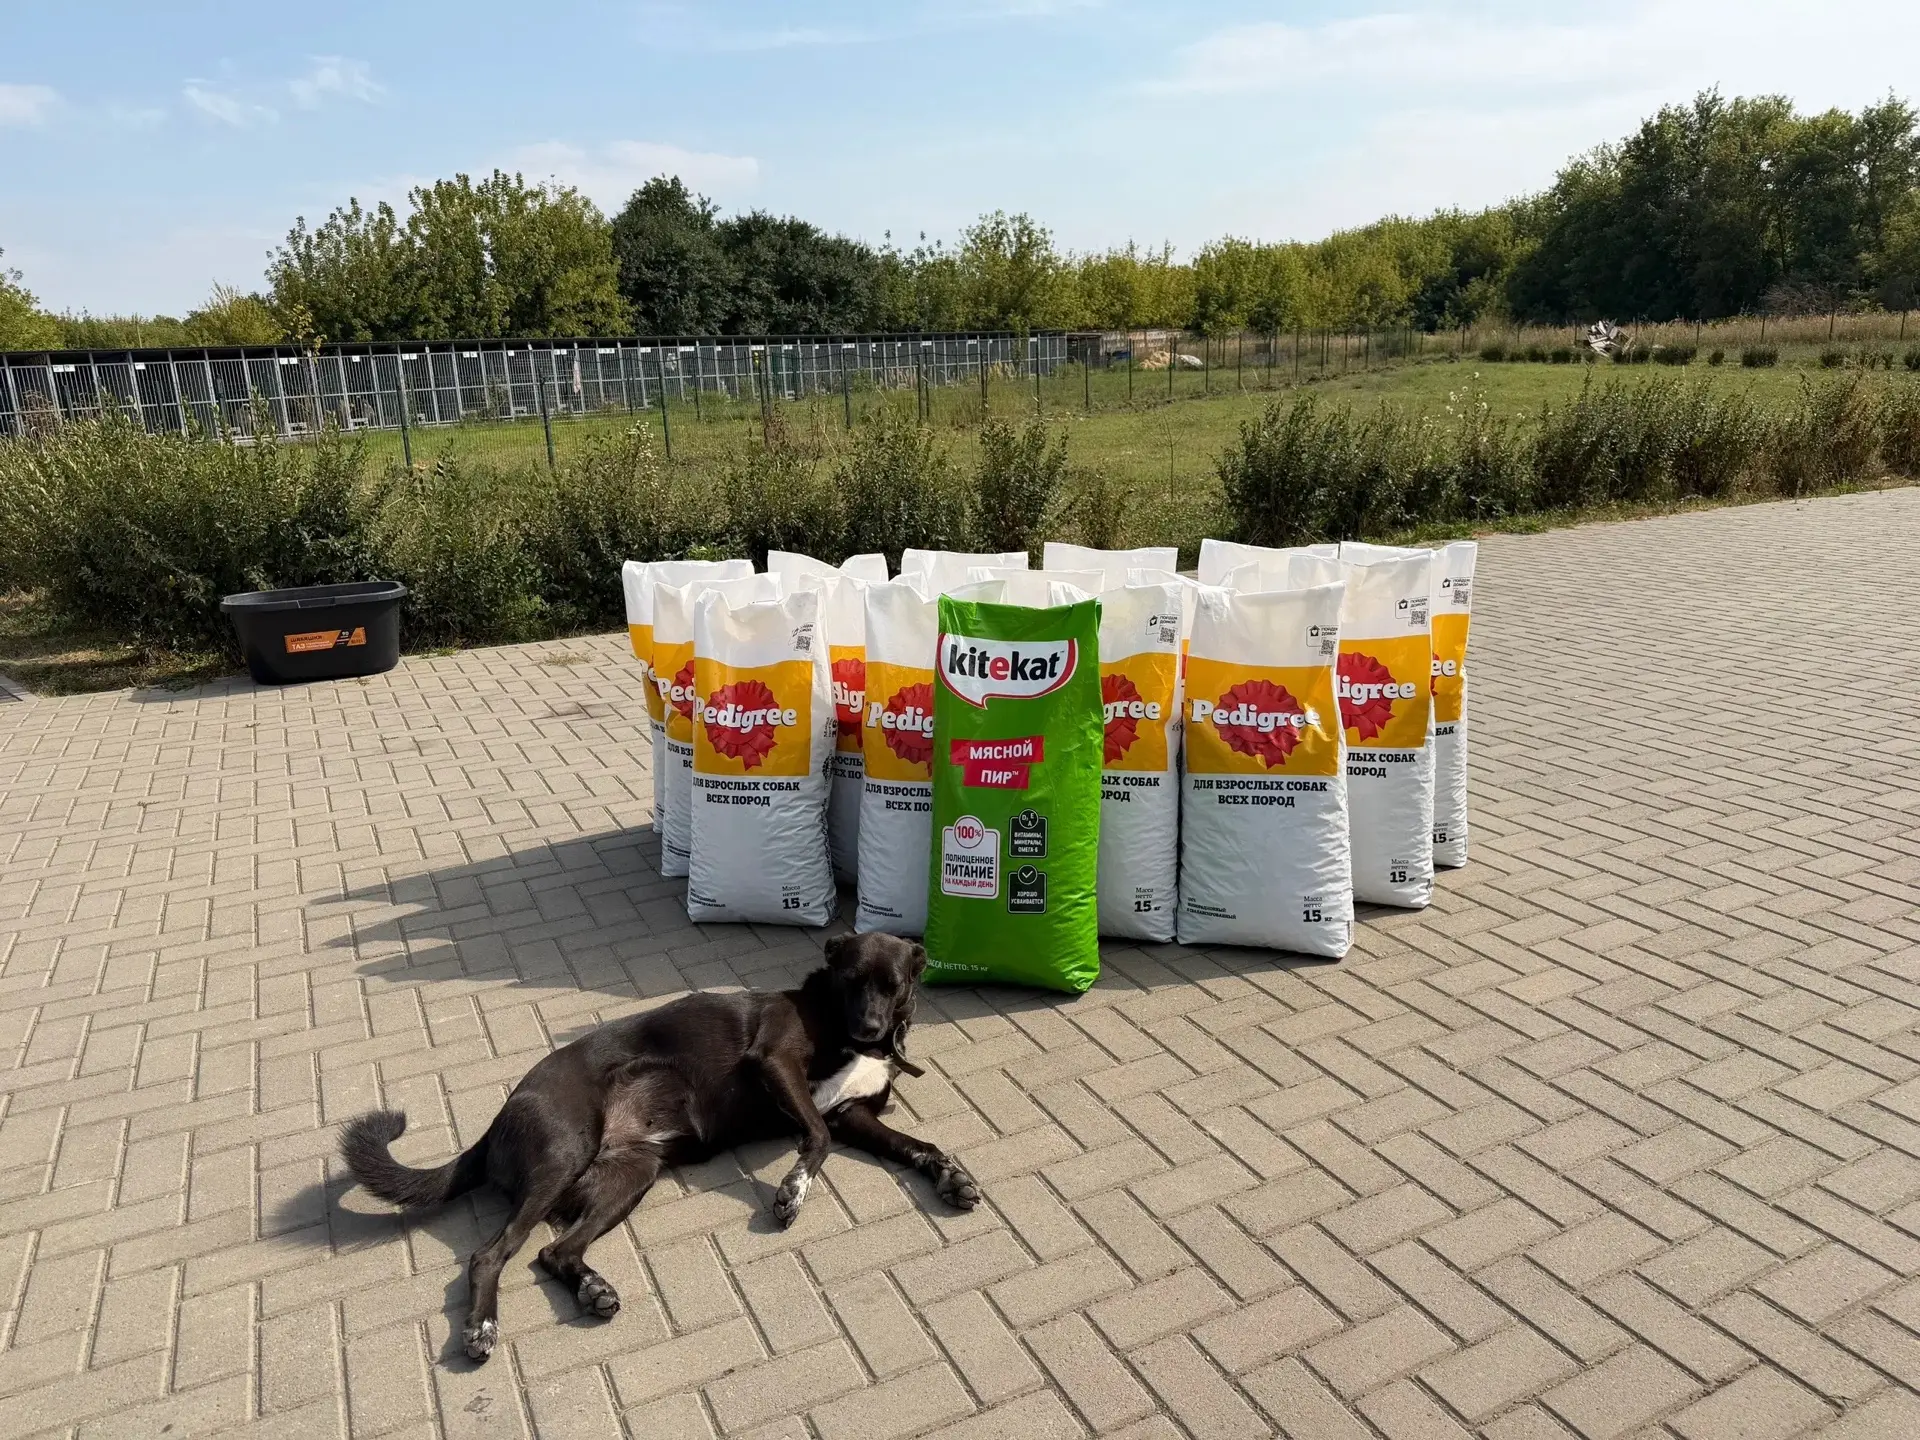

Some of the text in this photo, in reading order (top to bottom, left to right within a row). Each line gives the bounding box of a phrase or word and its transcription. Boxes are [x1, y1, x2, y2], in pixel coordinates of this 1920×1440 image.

[949, 644, 1060, 680] kitekat
[1104, 700, 1160, 724] gree
[1192, 698, 1321, 732] Pedigree
[866, 702, 934, 738] Pedig
[970, 740, 1033, 760] МЯСНОЙ
[1378, 753, 1416, 763] СОБАК
[1347, 766, 1387, 778] ПОРОД
[705, 780, 760, 791] ВЗРОСЛЫХ
[763, 781, 800, 791] СОБАК
[865, 782, 882, 794] ДЛЯ
[1122, 777, 1160, 787] СОБАК
[1193, 780, 1327, 792] ДЛЯ ВЗРОСЛЫХ СОБАК
[706, 793, 770, 806] ВСЕХ ПОРОД
[1101, 790, 1130, 802] ОРОД
[1218, 795, 1295, 808] ВСЕХ ПОРОД
[885, 800, 911, 811] ВСЕХ
[957, 826, 982, 839] 100%
[945, 853, 994, 865] ПОЛНОЦЕННОЕ
[945, 863, 994, 879] ПИТАНИЕ
[1390, 871, 1406, 883] 15
[952, 878, 976, 887] КАЖДЫЙ
[978, 880, 994, 888] ДЕНЬ
[782, 897, 800, 909] 15
[1134, 900, 1151, 912] 15
[1303, 910, 1321, 922] 15
